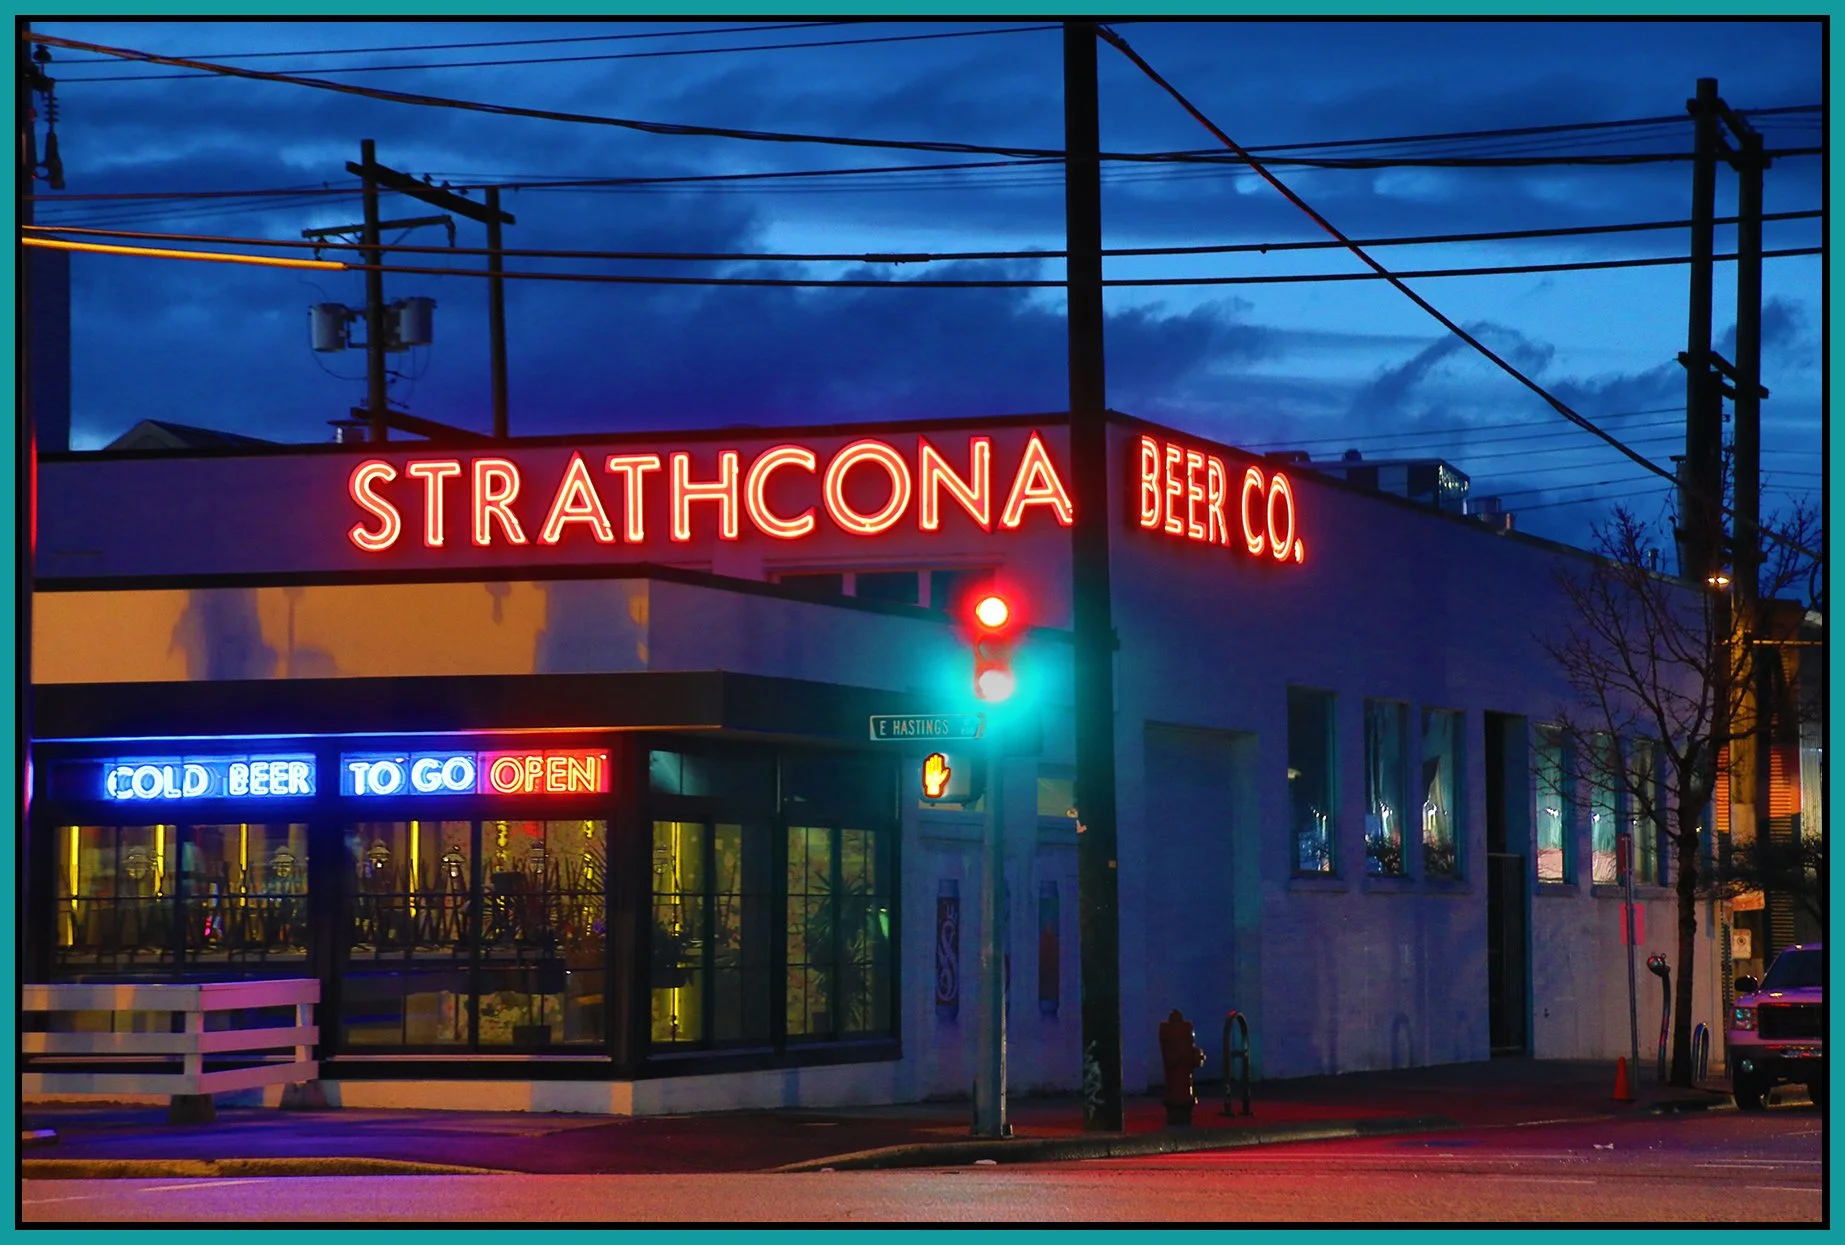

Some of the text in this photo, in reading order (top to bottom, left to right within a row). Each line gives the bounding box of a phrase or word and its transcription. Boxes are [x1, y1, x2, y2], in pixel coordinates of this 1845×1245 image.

[349, 429, 1074, 551] STRATHCONA
[1140, 435, 1304, 563] BEER CO.
[879, 720, 887, 736] E
[892, 719, 949, 736] HASTINGS
[107, 757, 475, 799] COLD BEER TO GO
[490, 757, 597, 792] OPEN
